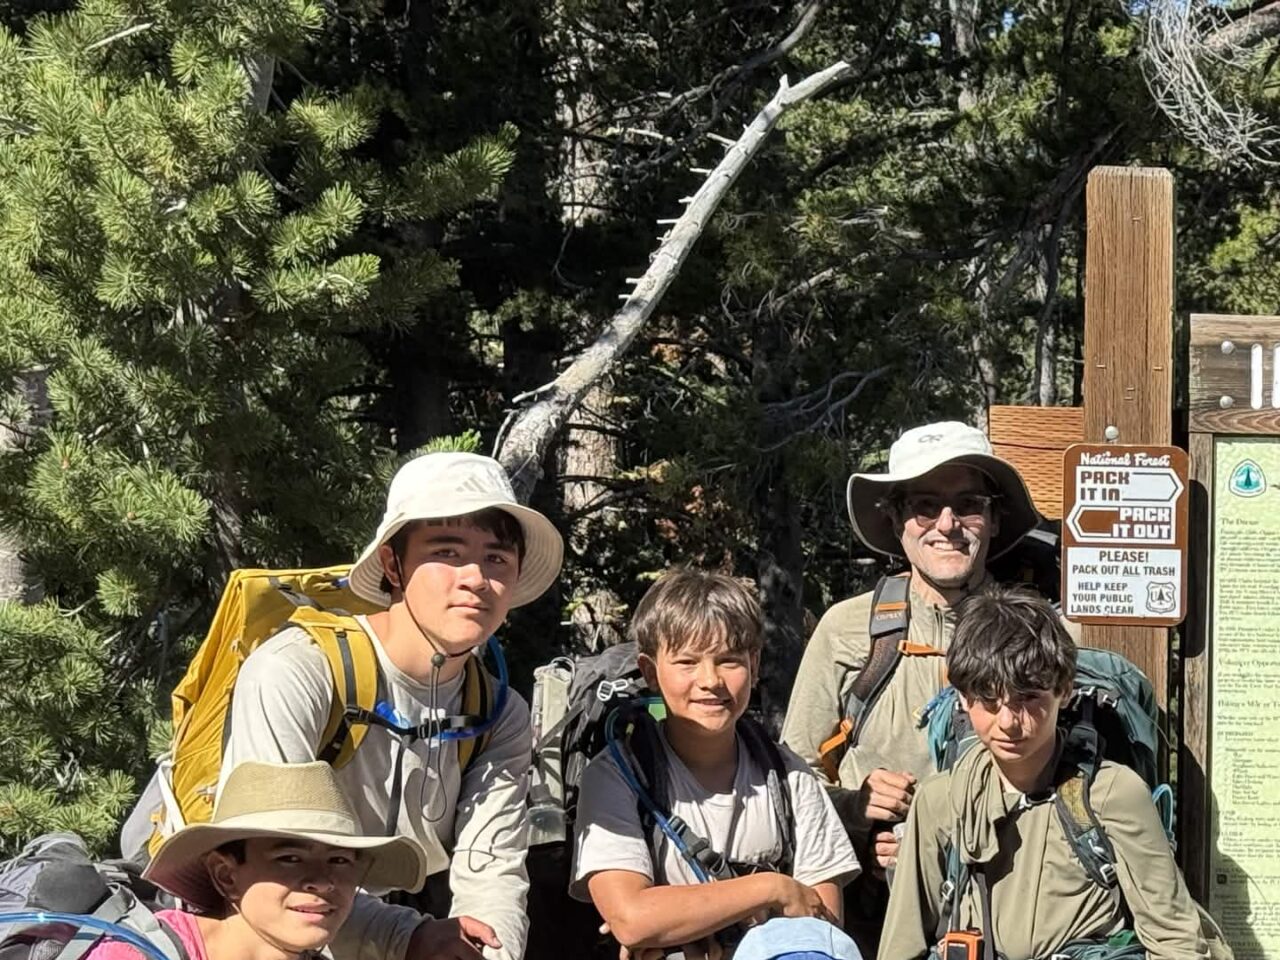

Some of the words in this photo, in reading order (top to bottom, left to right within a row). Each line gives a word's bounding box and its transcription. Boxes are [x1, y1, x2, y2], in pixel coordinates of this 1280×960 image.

[1080, 451, 1131, 466] National
[1134, 453, 1171, 466] Forest
[1080, 471, 1130, 485] PACK
[1080, 487, 1097, 501] IT
[1119, 507, 1171, 522] PACK
[1112, 523, 1134, 538] IT
[1136, 524, 1171, 539] OUT
[1099, 551, 1149, 563] PLEASE!
[1072, 564, 1099, 575] PACK
[1101, 565, 1119, 575] OUT
[1122, 565, 1141, 577] ALL
[1143, 566, 1176, 576] TRASH
[1077, 582, 1101, 591] HELP
[1104, 582, 1128, 591] KEEP
[1072, 593, 1097, 602] YOUR
[1100, 594, 1133, 603] PUBLIC
[1070, 604, 1101, 614] LANDS
[1103, 604, 1134, 614] CLEAN
